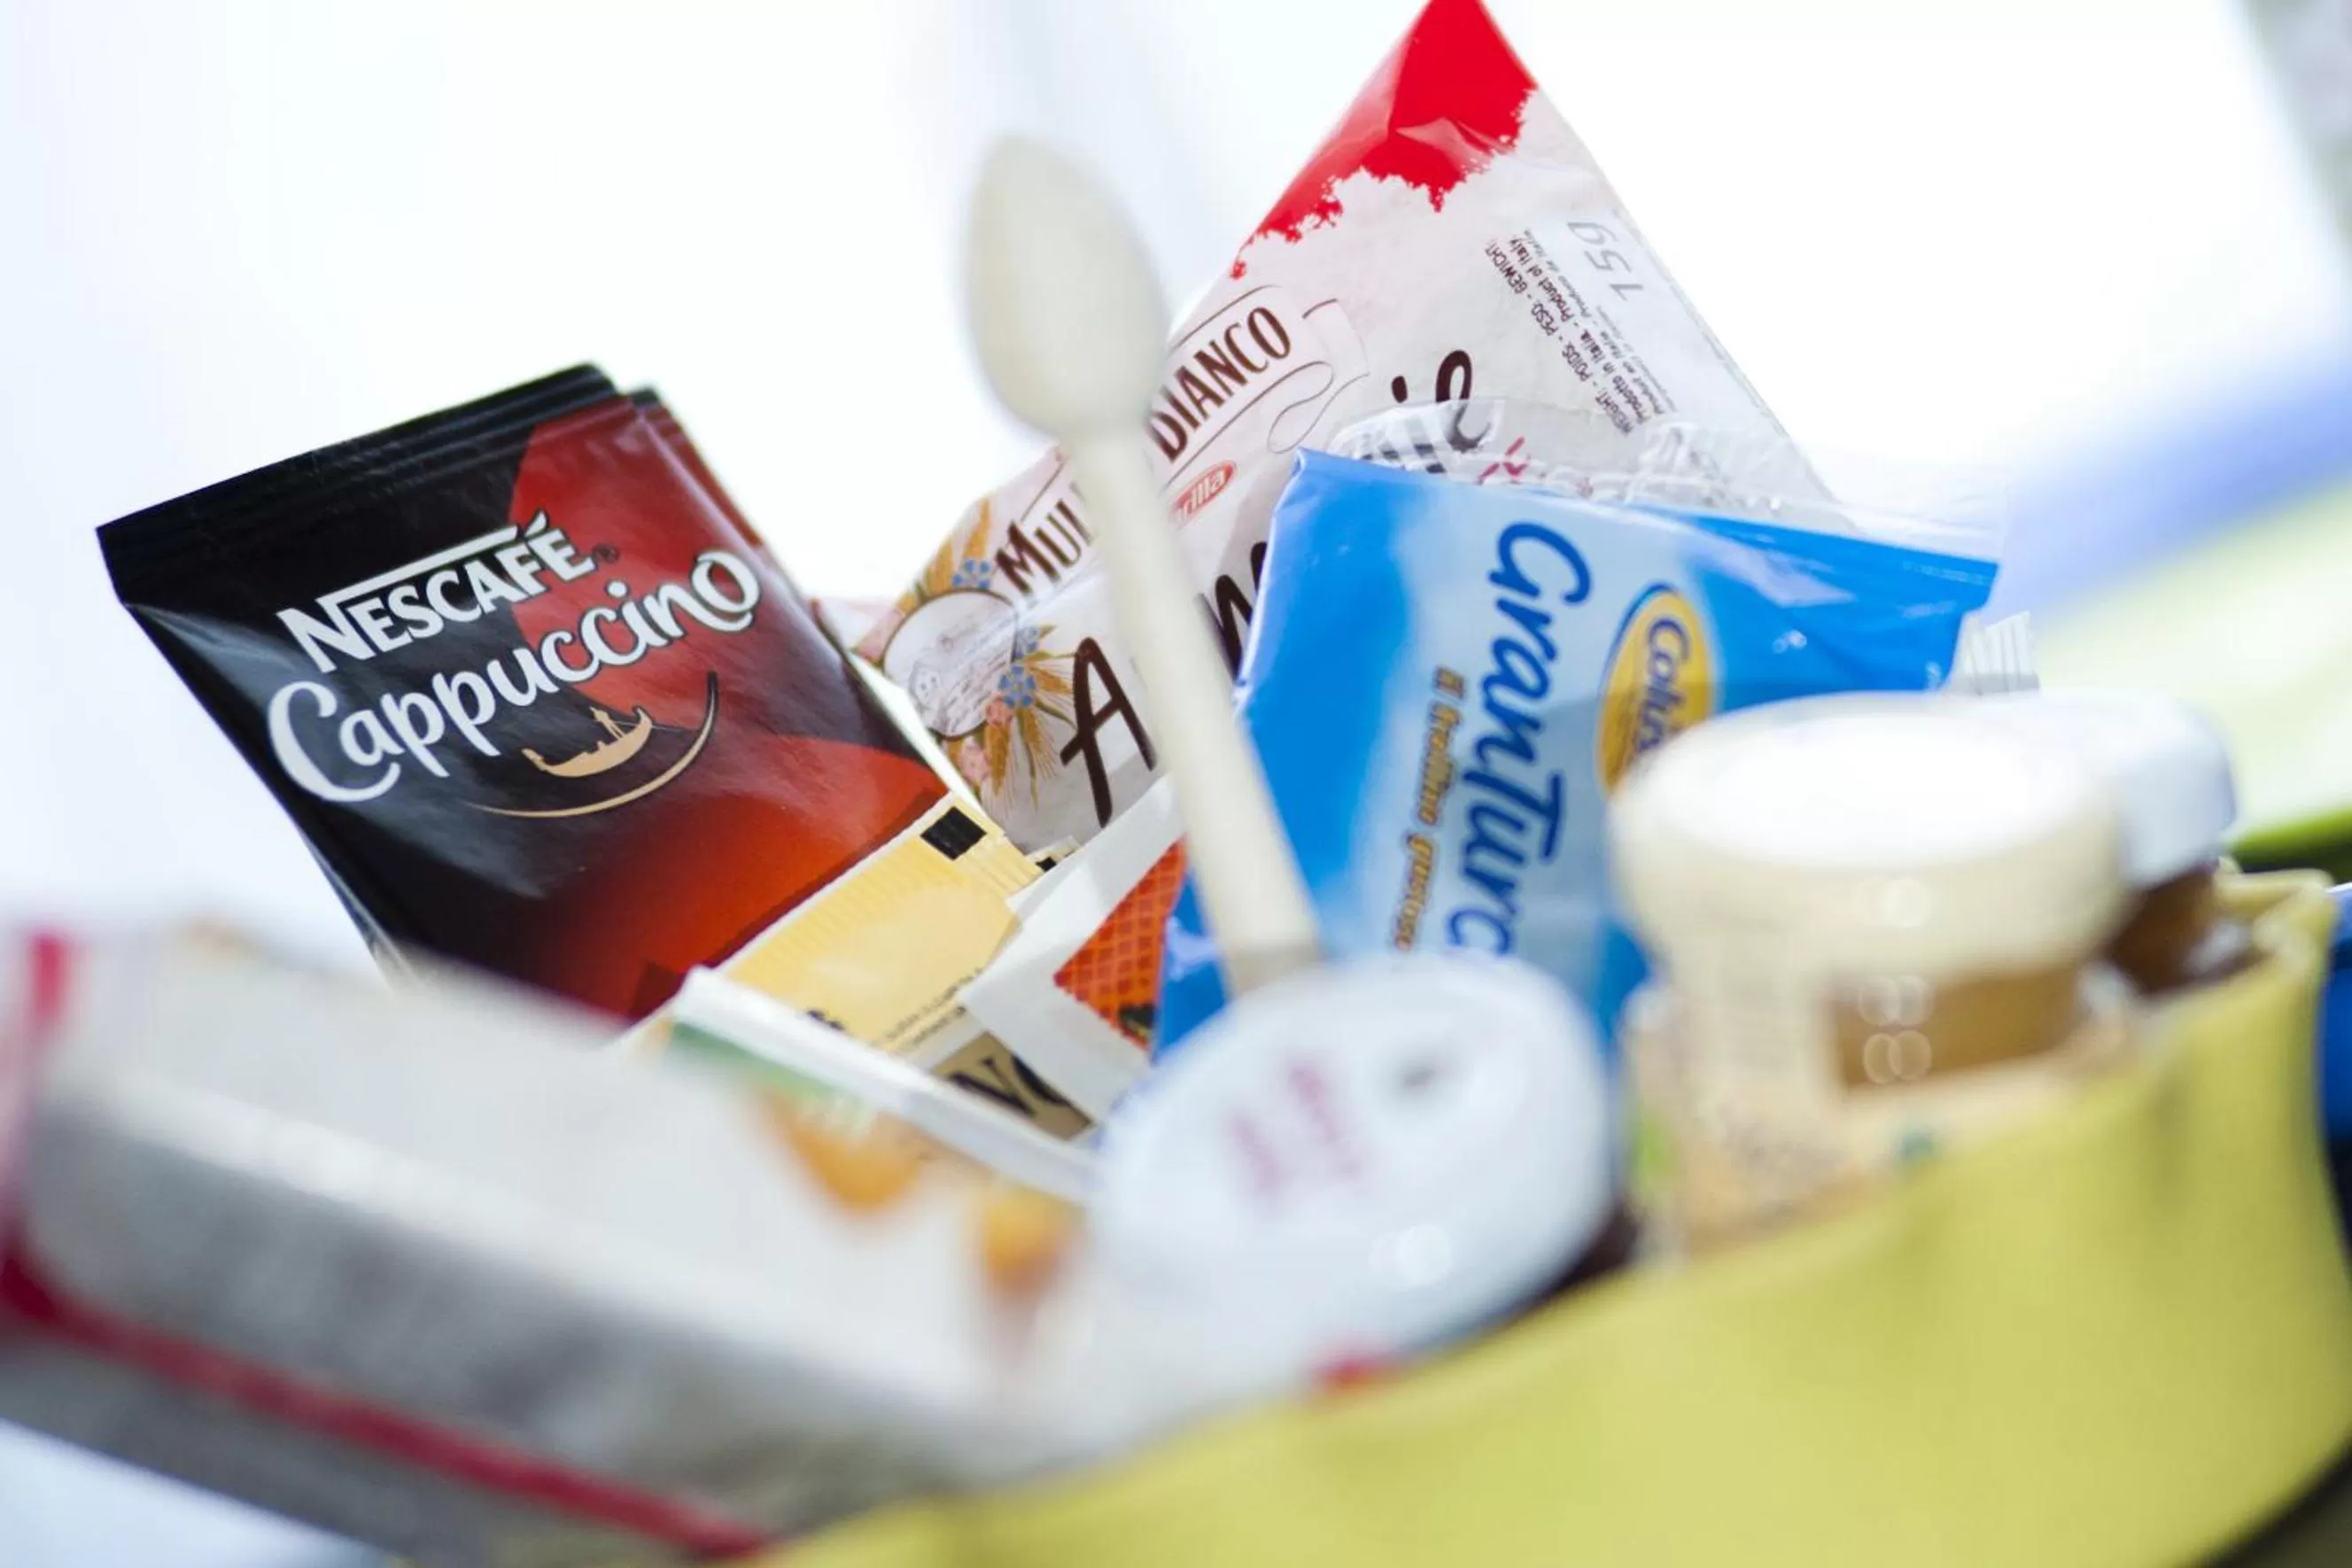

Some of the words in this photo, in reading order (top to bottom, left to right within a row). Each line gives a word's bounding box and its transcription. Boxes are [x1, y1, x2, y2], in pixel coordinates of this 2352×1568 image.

[1525, 263, 1544, 277] of
[1566, 221, 1645, 302] 15g
[1537, 276, 1576, 323] Product
[1601, 361, 1617, 377] in
[1611, 375, 1651, 426] Prodotto
[276, 509, 597, 673] NESCAFÉ
[268, 549, 762, 803] Cappuccino
[1446, 521, 1592, 957] GranTurc
